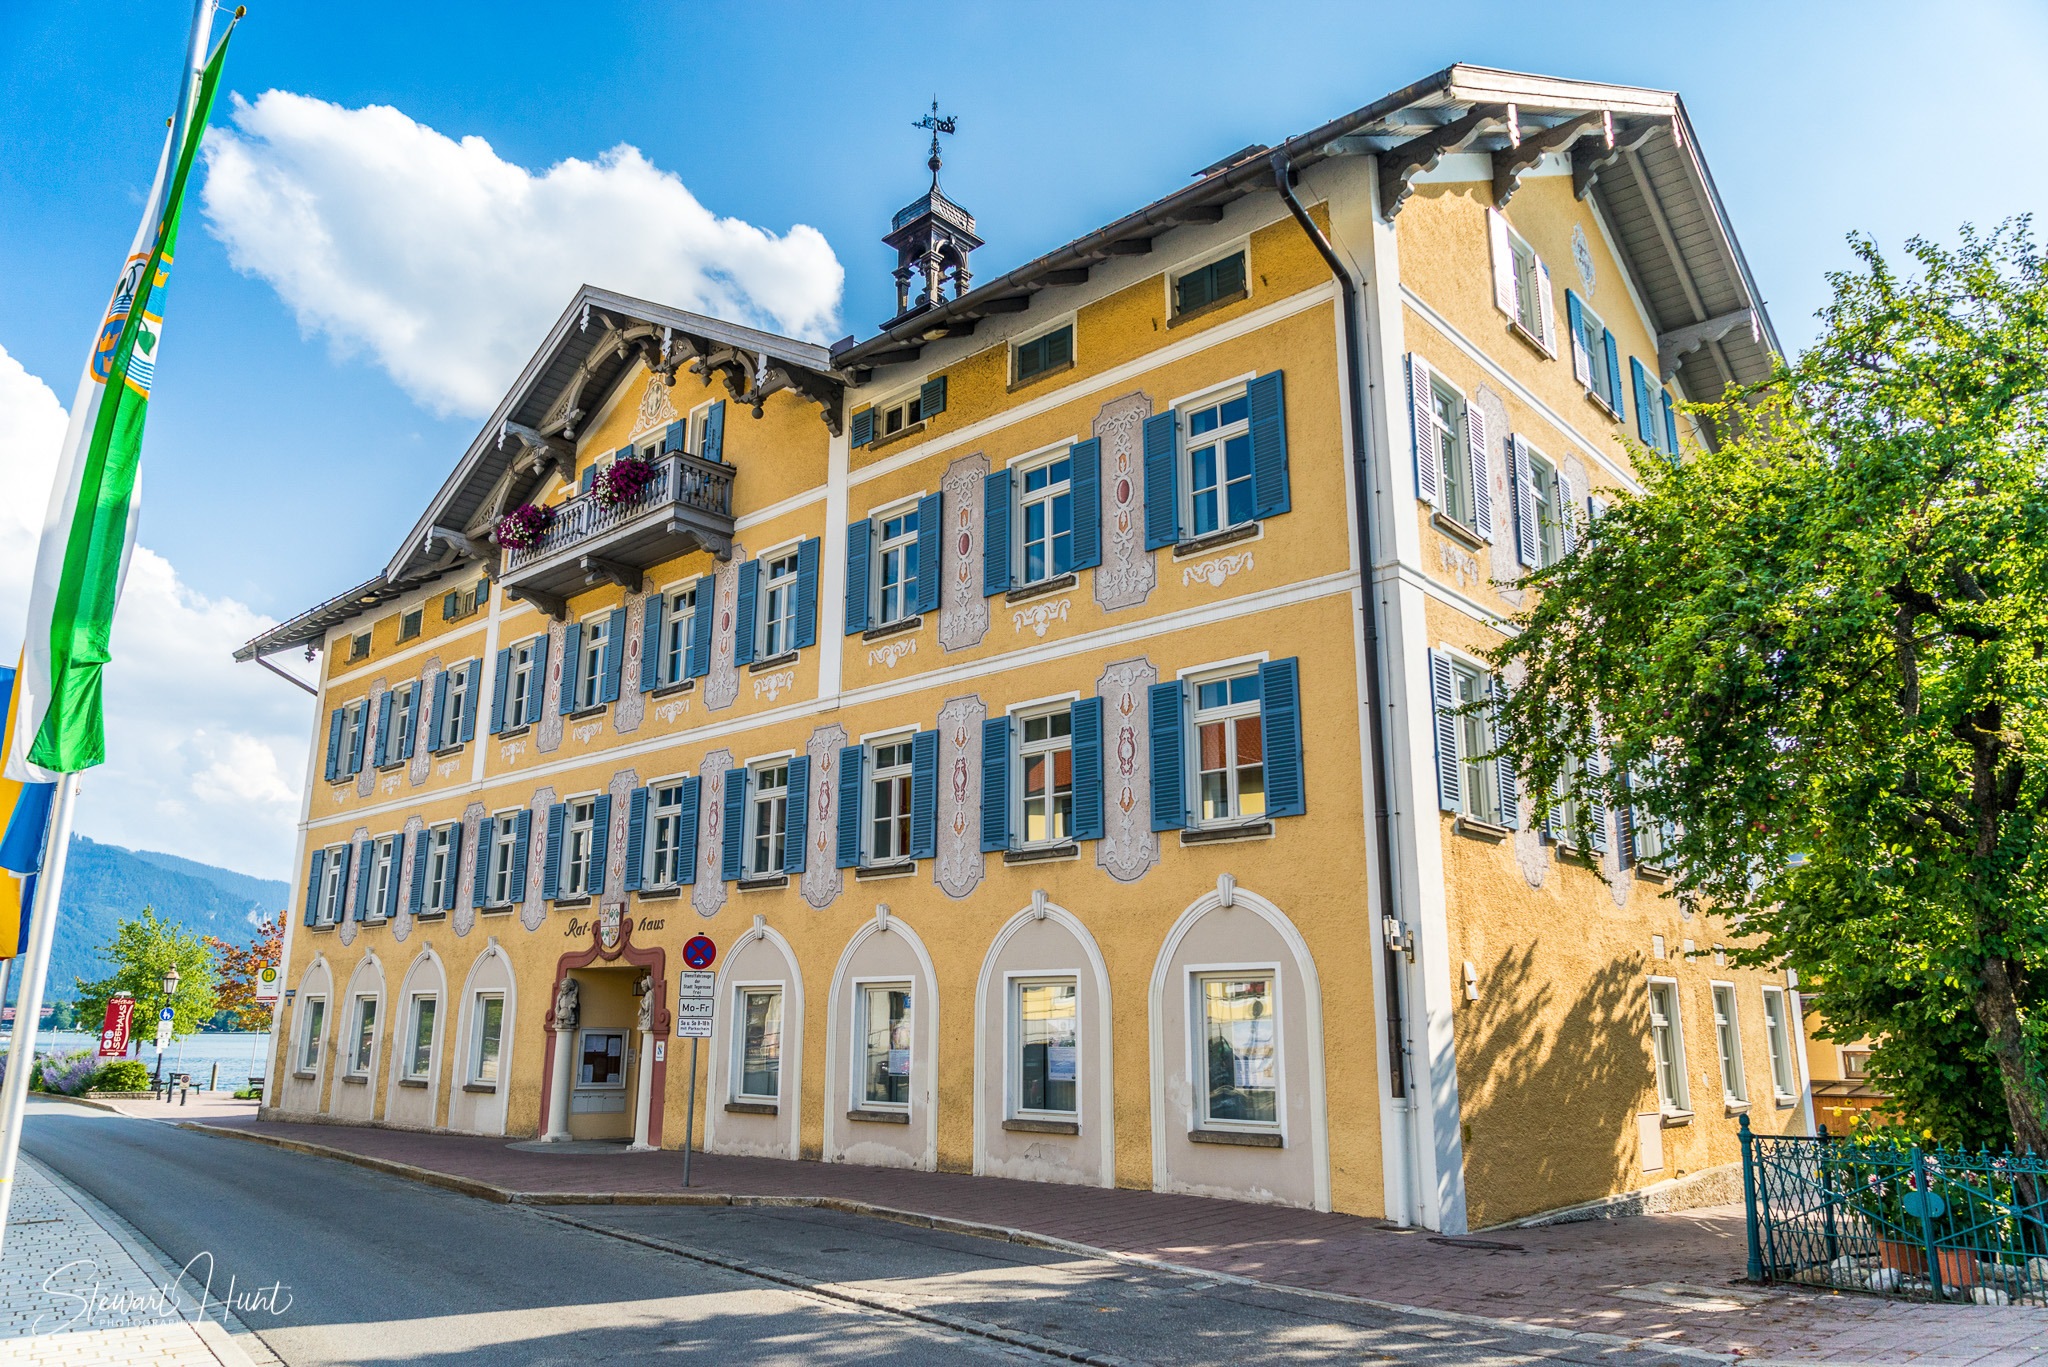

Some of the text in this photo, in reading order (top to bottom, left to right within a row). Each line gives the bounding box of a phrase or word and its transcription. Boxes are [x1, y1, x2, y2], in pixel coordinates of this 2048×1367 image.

[564, 917, 665, 938] Rat- haus
[682, 1003, 710, 1012] Mo-Fr
